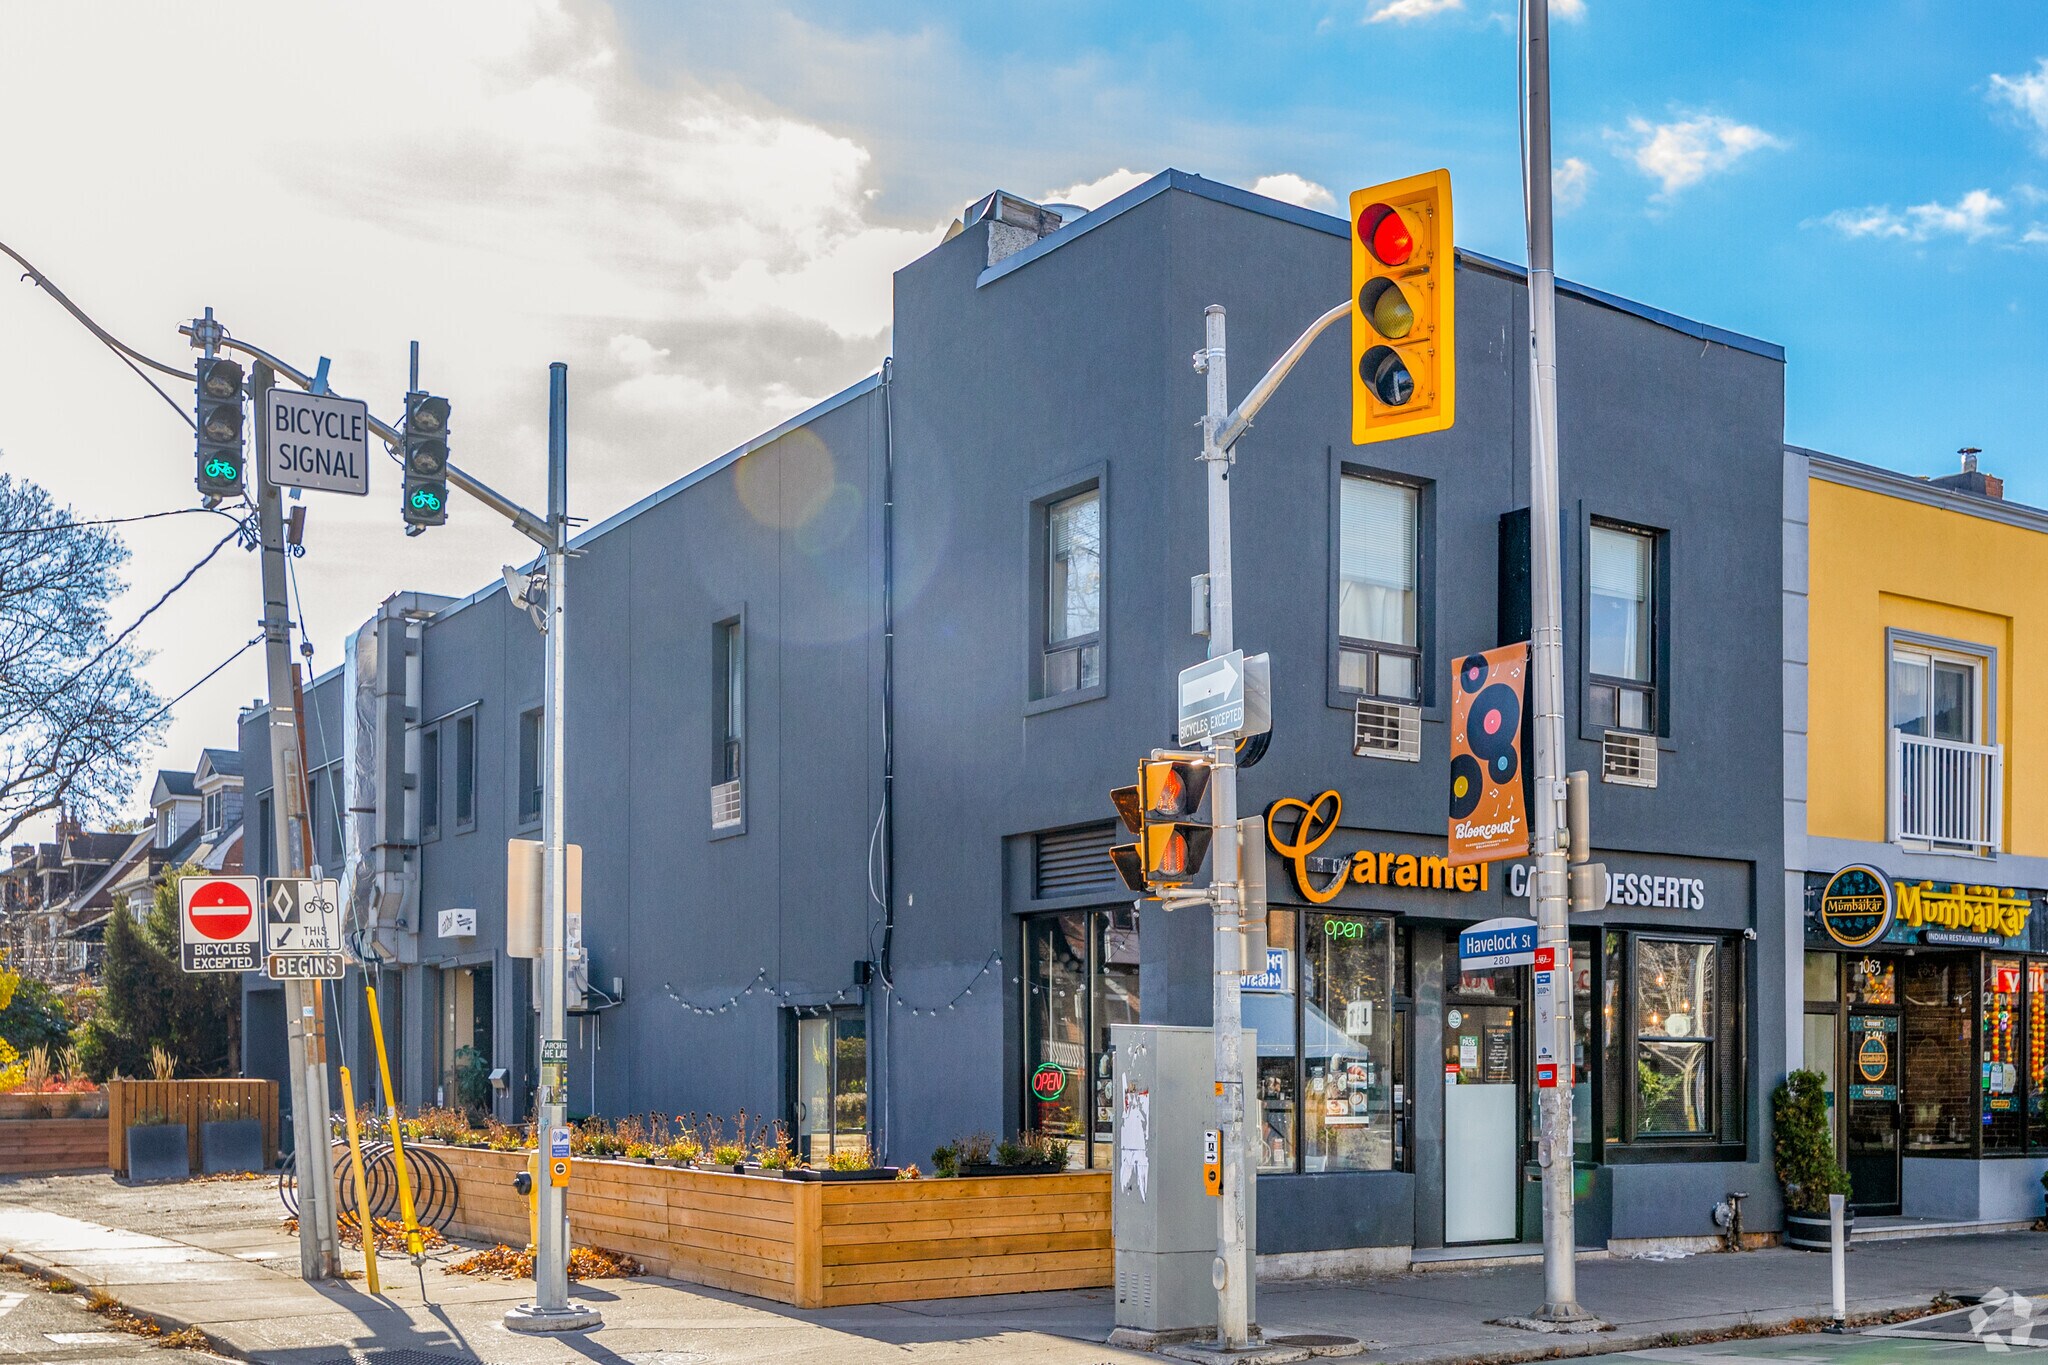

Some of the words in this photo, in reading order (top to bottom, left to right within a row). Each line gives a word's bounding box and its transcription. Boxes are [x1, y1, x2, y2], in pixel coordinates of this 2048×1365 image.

[275, 404, 362, 442] BICYCLE
[278, 443, 360, 479] SIGNAL
[1210, 706, 1242, 730] EXCEPTED
[1180, 718, 1208, 740] BICYCLES
[1827, 898, 1883, 913] Mumbaikar
[1893, 880, 2032, 938] Mumbaikar
[303, 926, 327, 936] THIS
[1324, 920, 1364, 941] open
[1928, 932, 1949, 941] INDIAN
[1949, 934, 1983, 943] RESTAURANT
[1984, 936, 1988, 944] &
[1989, 937, 2000, 945] BAR
[194, 943, 251, 956] BICYCLES
[301, 938, 331, 948] LANE
[1466, 932, 1518, 954] Havelock
[1521, 934, 1531, 948] St
[193, 957, 253, 970] EXCEPTED
[276, 957, 337, 976] BEGINS
[1493, 955, 1511, 966] 280
[1859, 958, 1881, 976] 1063
[544, 1042, 562, 1050] ARCH
[1033, 1072, 1063, 1091] OPEN
